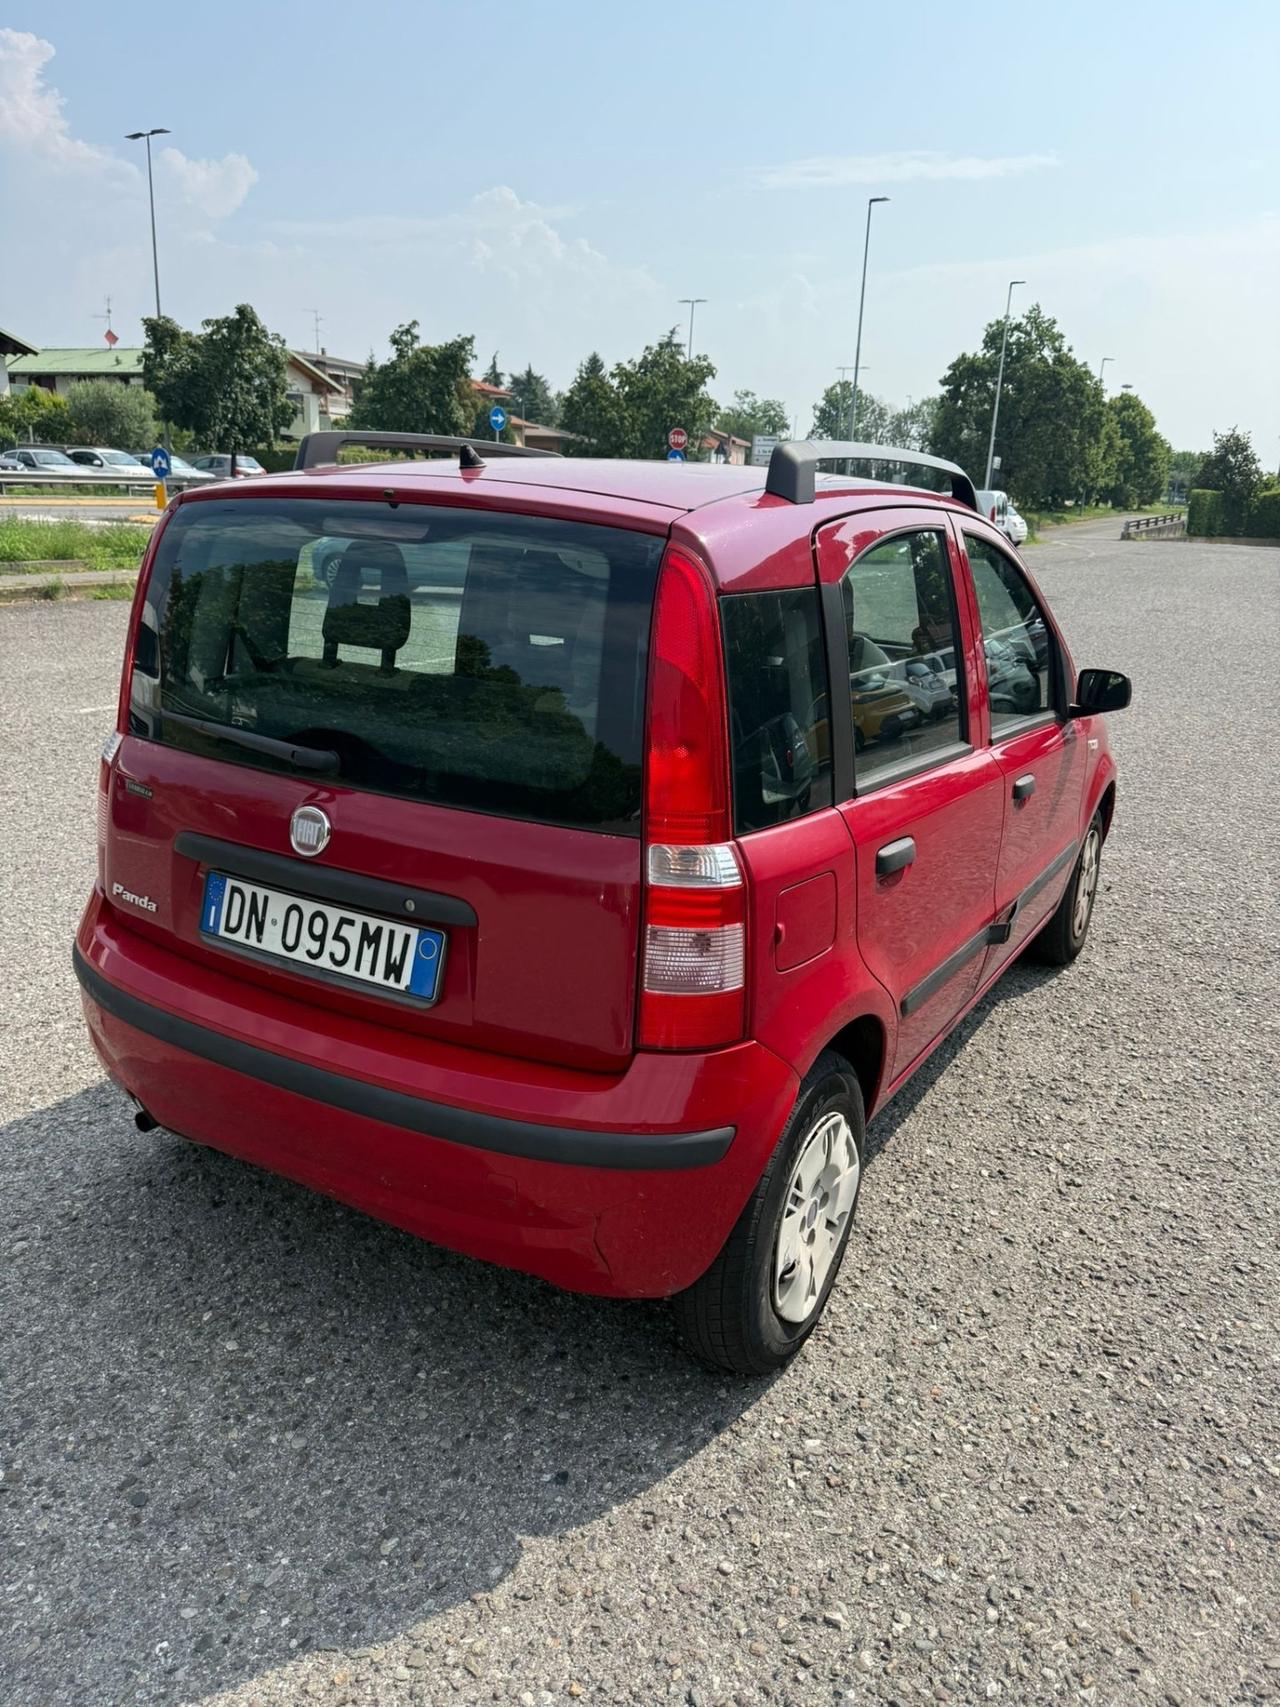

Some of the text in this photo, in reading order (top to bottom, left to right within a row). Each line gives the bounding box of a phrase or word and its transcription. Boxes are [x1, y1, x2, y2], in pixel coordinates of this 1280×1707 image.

[671, 435, 685, 443] STOP
[298, 818, 321, 845] FIAT
[112, 882, 157, 912] Panda
